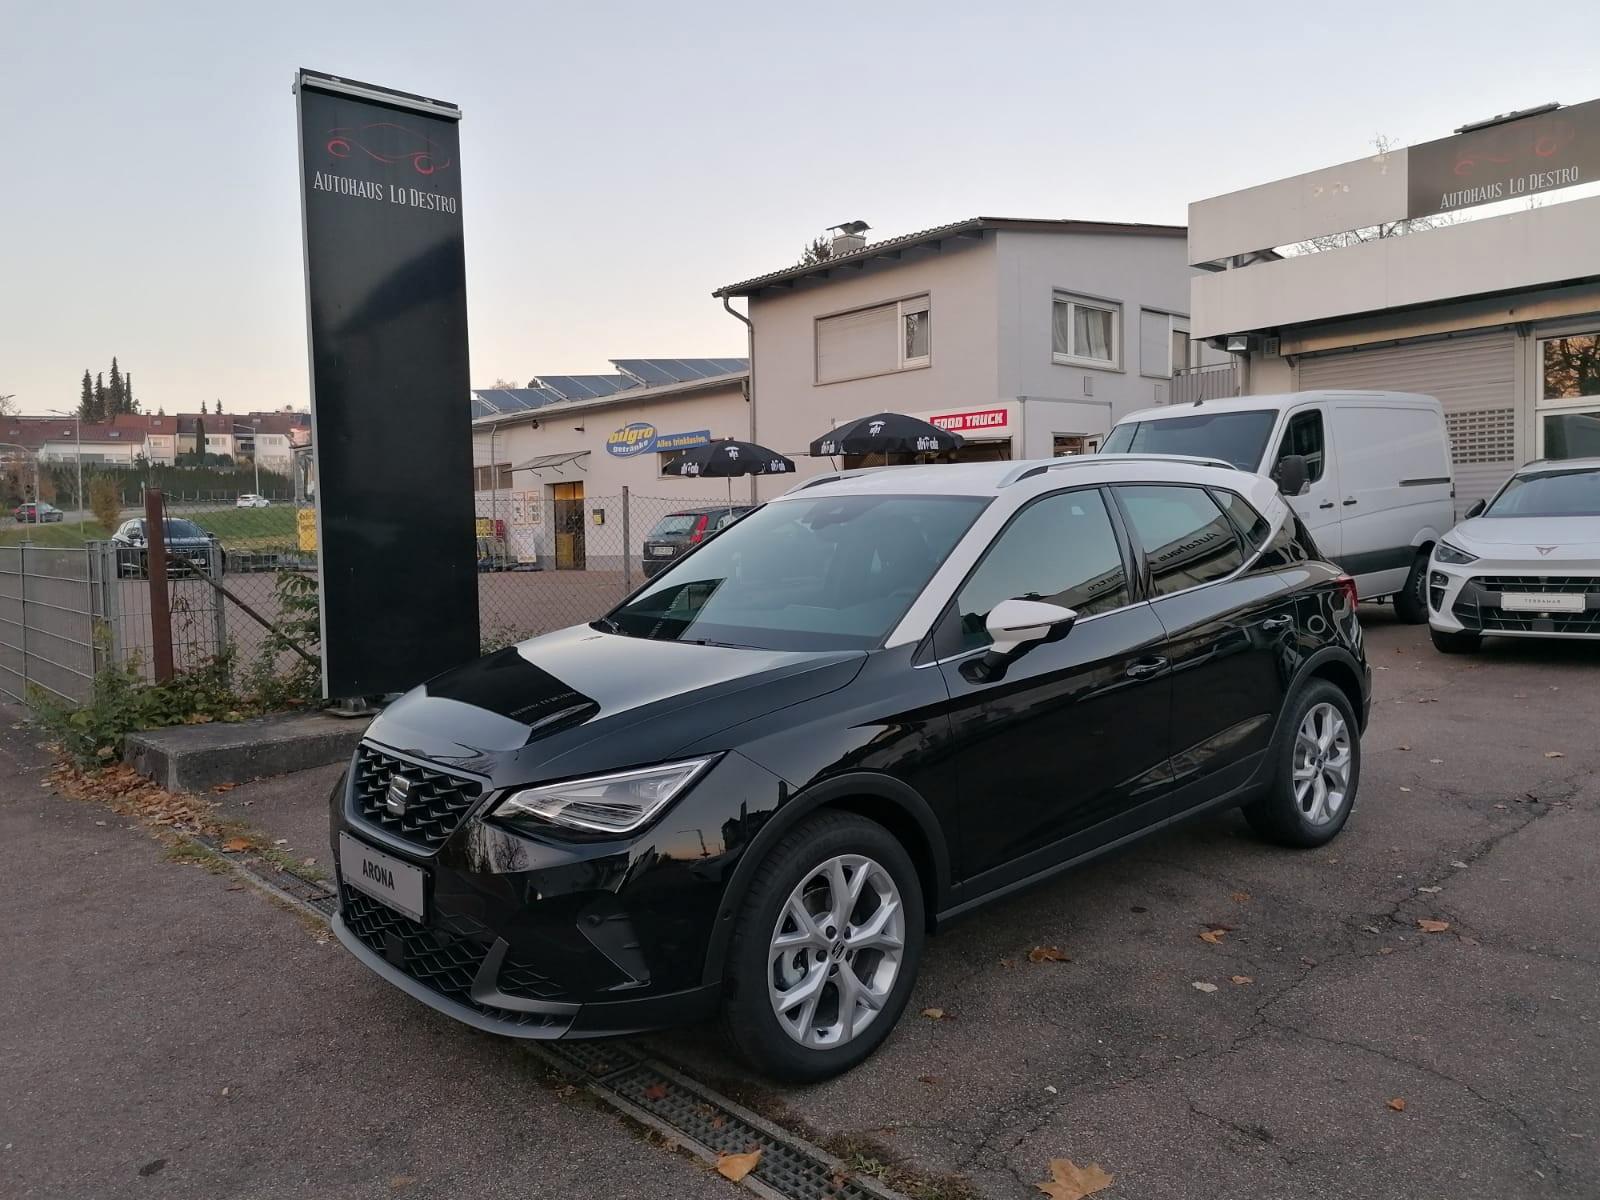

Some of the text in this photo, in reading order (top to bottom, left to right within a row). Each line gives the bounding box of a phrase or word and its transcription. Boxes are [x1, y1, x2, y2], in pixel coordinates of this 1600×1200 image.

[313, 170, 457, 214] AUTOHAUS LO DESTRO
[1440, 166, 1579, 209] AUTOHAUS LO DESTRO
[965, 412, 1004, 427] TRUCK
[362, 858, 395, 890] ARONA
